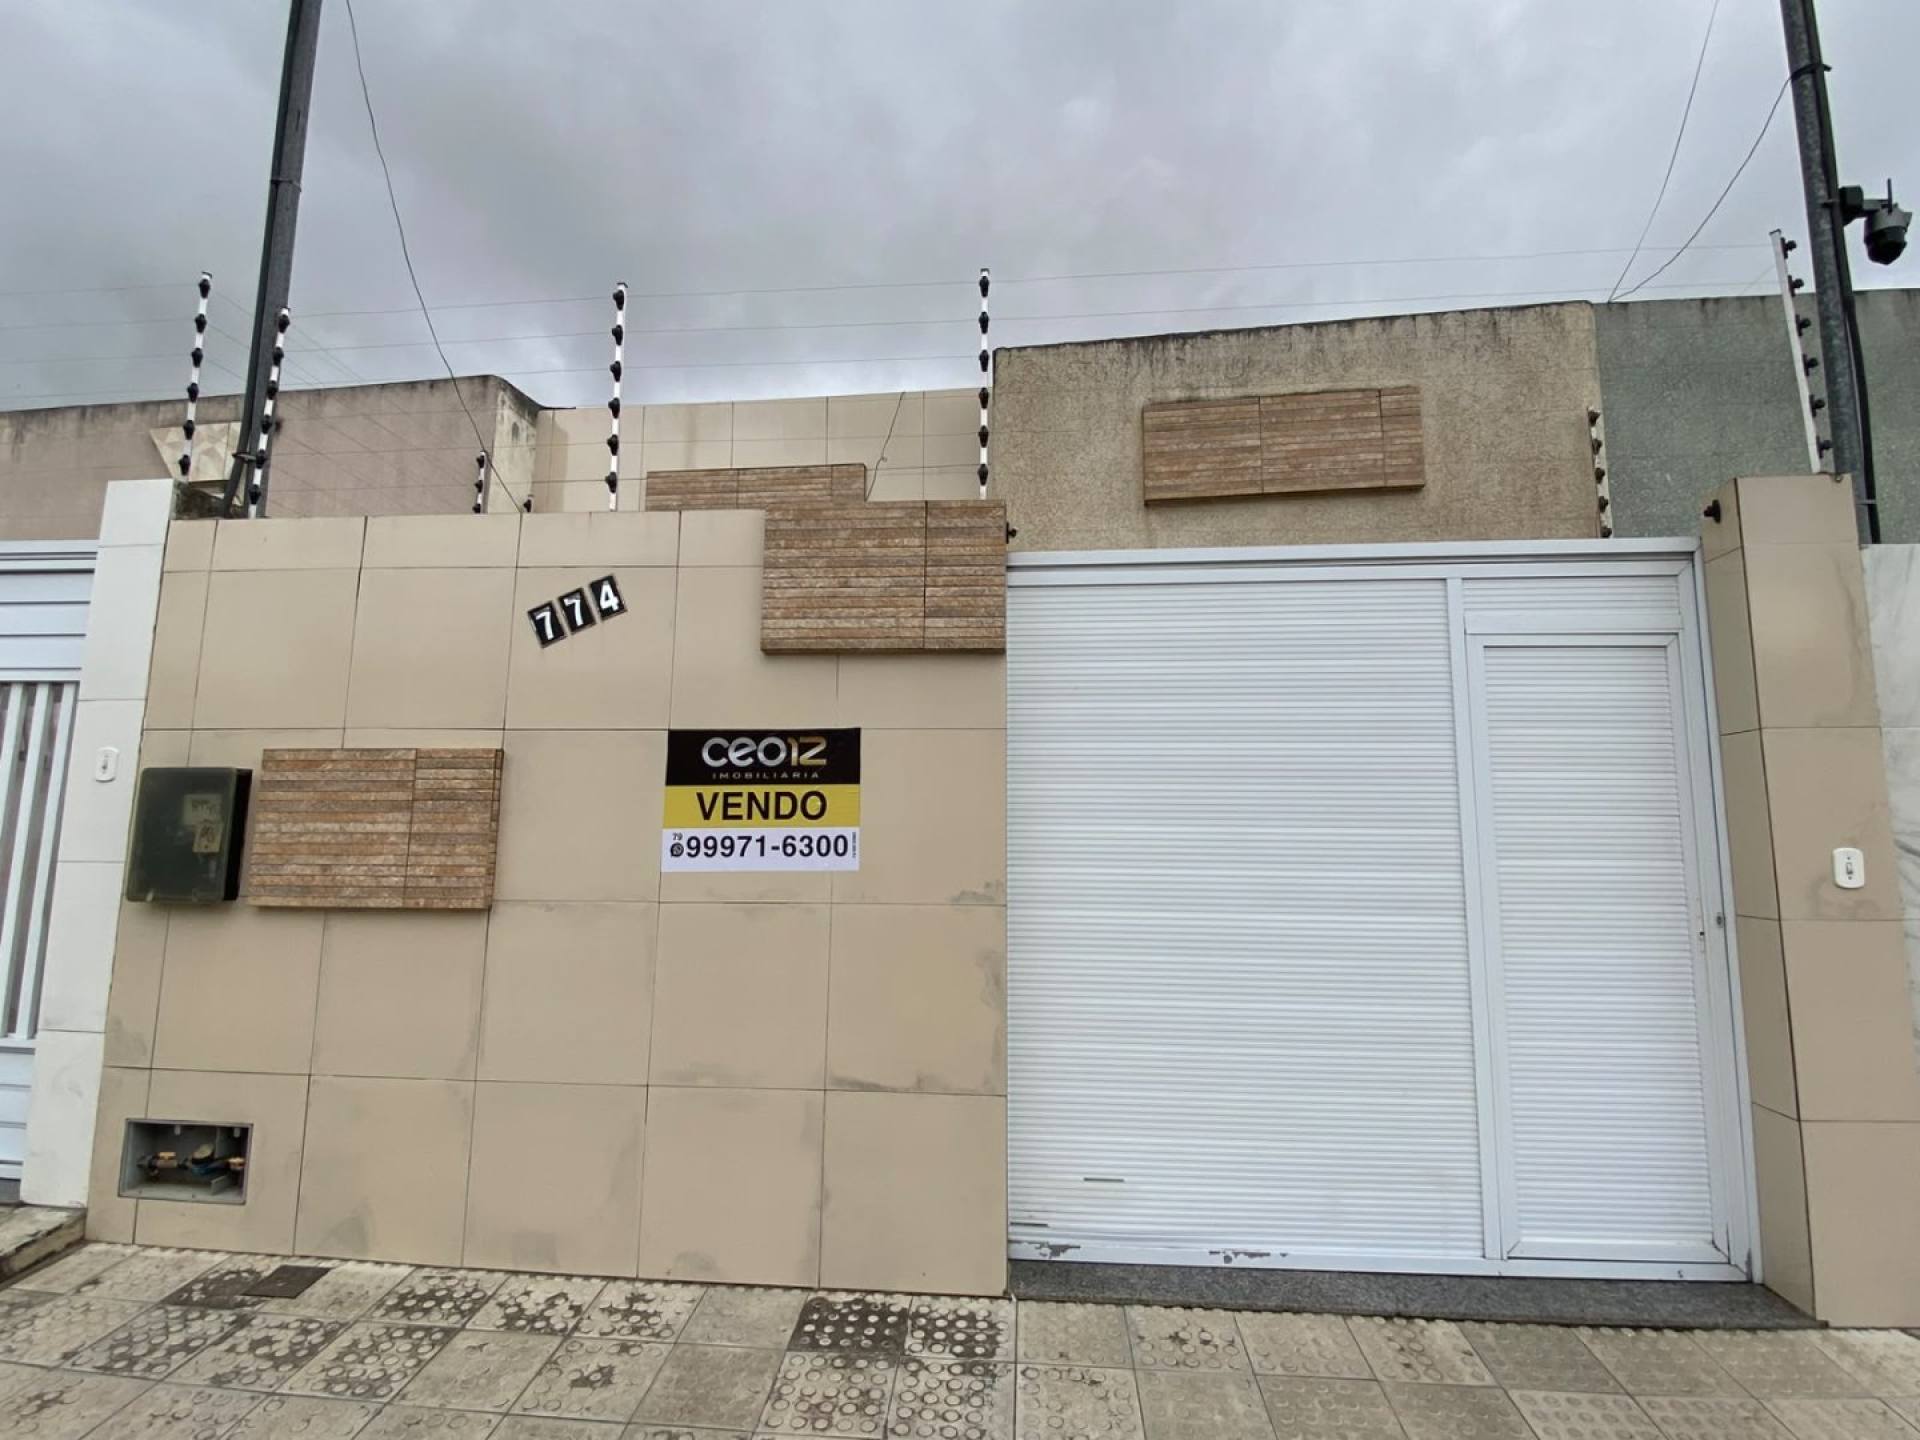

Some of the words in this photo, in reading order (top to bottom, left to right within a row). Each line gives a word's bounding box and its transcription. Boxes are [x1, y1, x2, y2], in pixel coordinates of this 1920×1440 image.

[534, 580, 620, 641] 774
[696, 790, 828, 821] VENDO
[686, 835, 849, 858] 99971-6300
